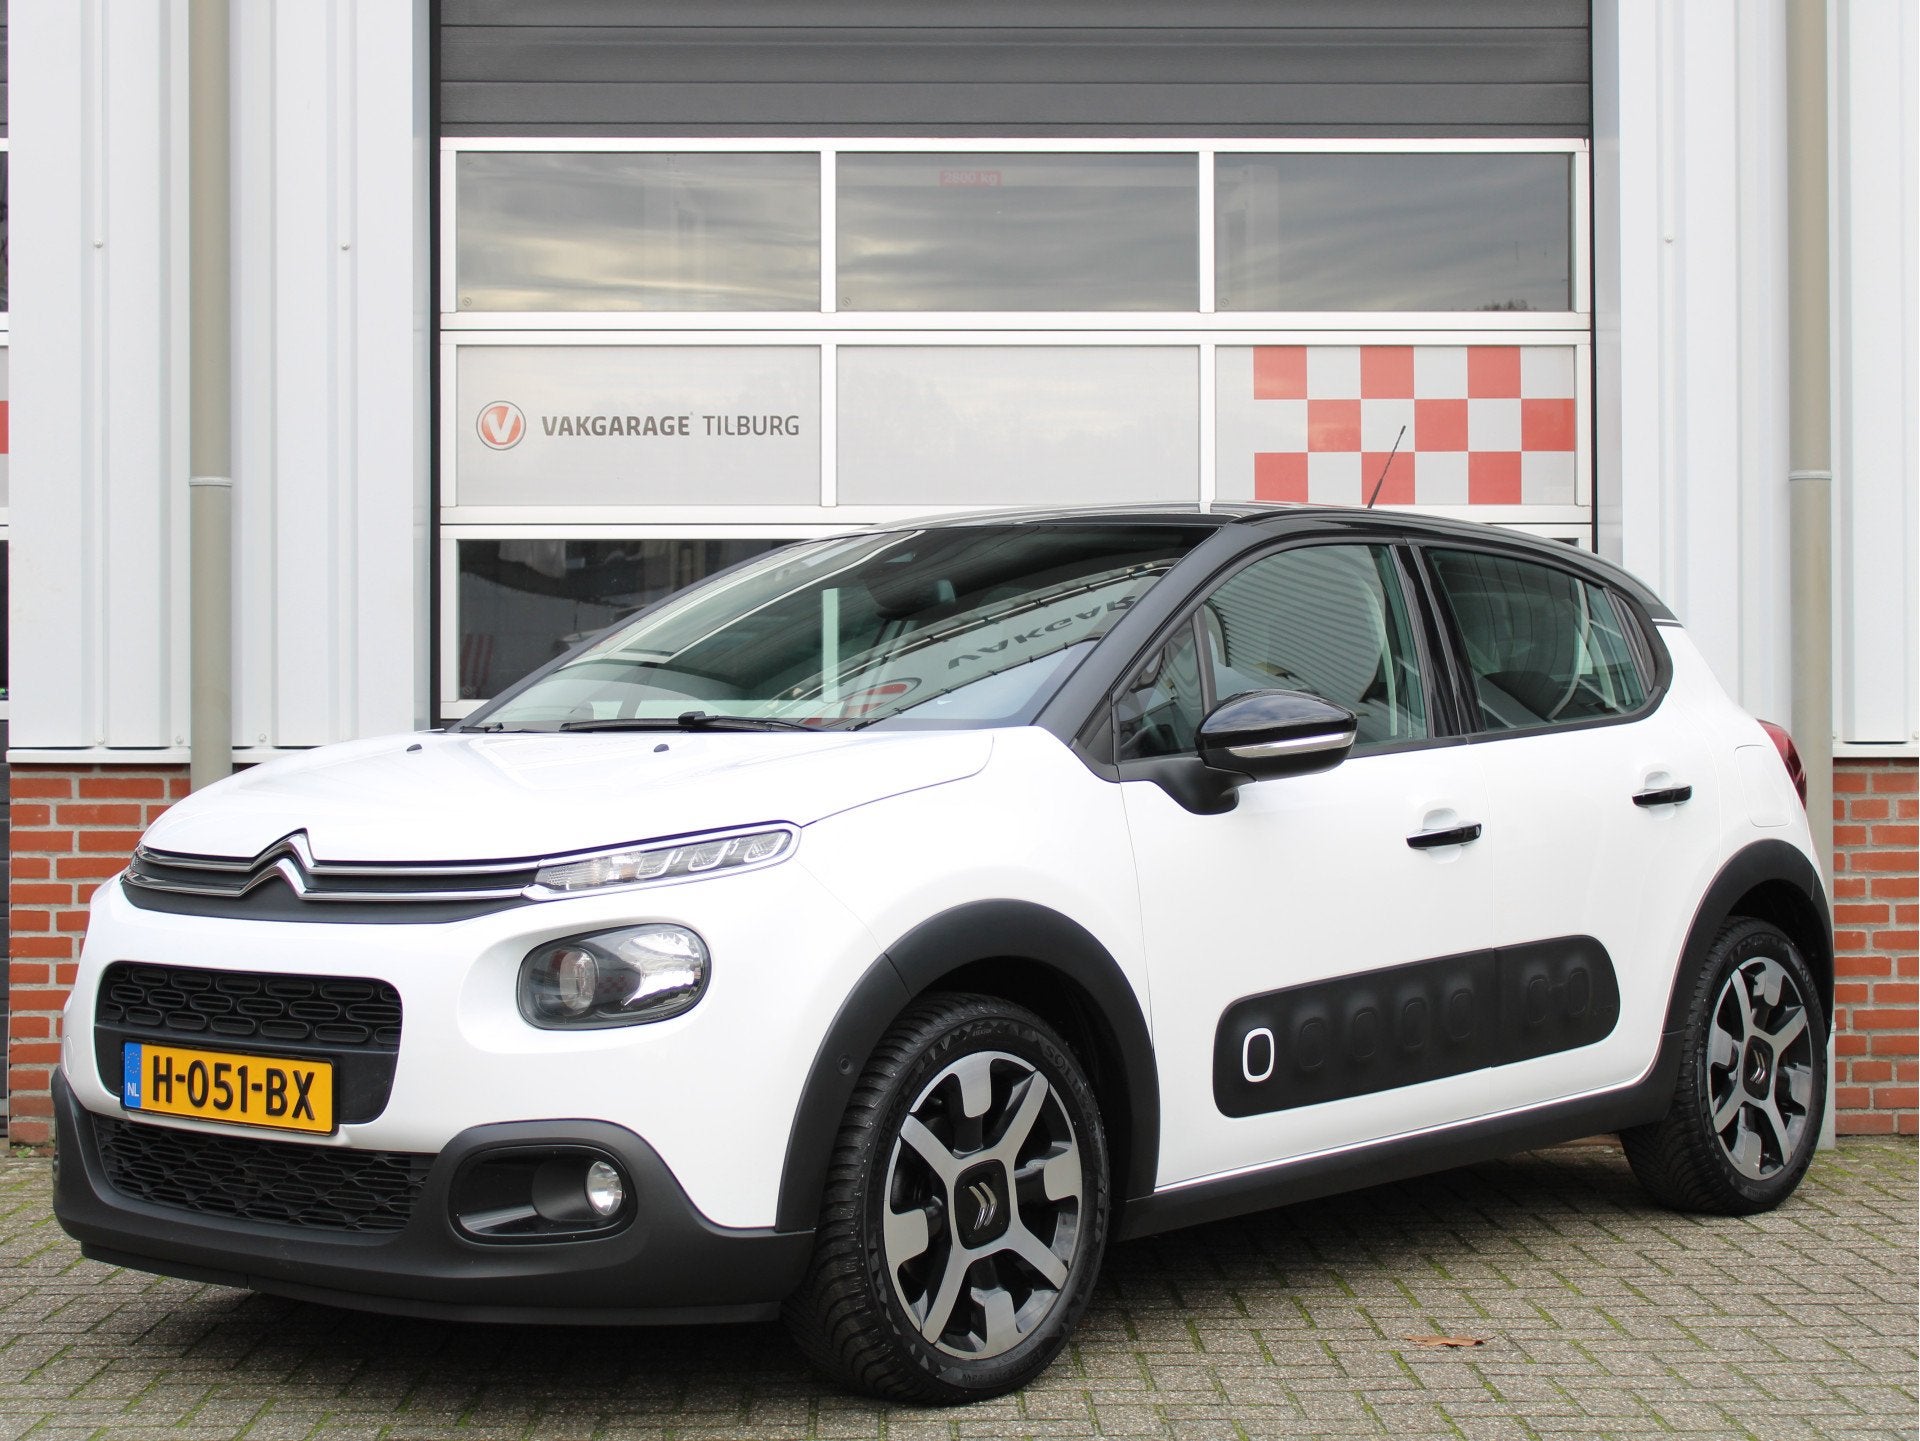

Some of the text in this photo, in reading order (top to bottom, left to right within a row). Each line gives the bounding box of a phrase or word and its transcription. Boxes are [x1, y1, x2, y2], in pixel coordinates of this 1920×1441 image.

[944, 171, 998, 186] 2800 kg
[541, 414, 800, 437] VAKGARAGE TILBURG
[127, 1082, 140, 1098] NL
[152, 1054, 316, 1121] H-051-BX
